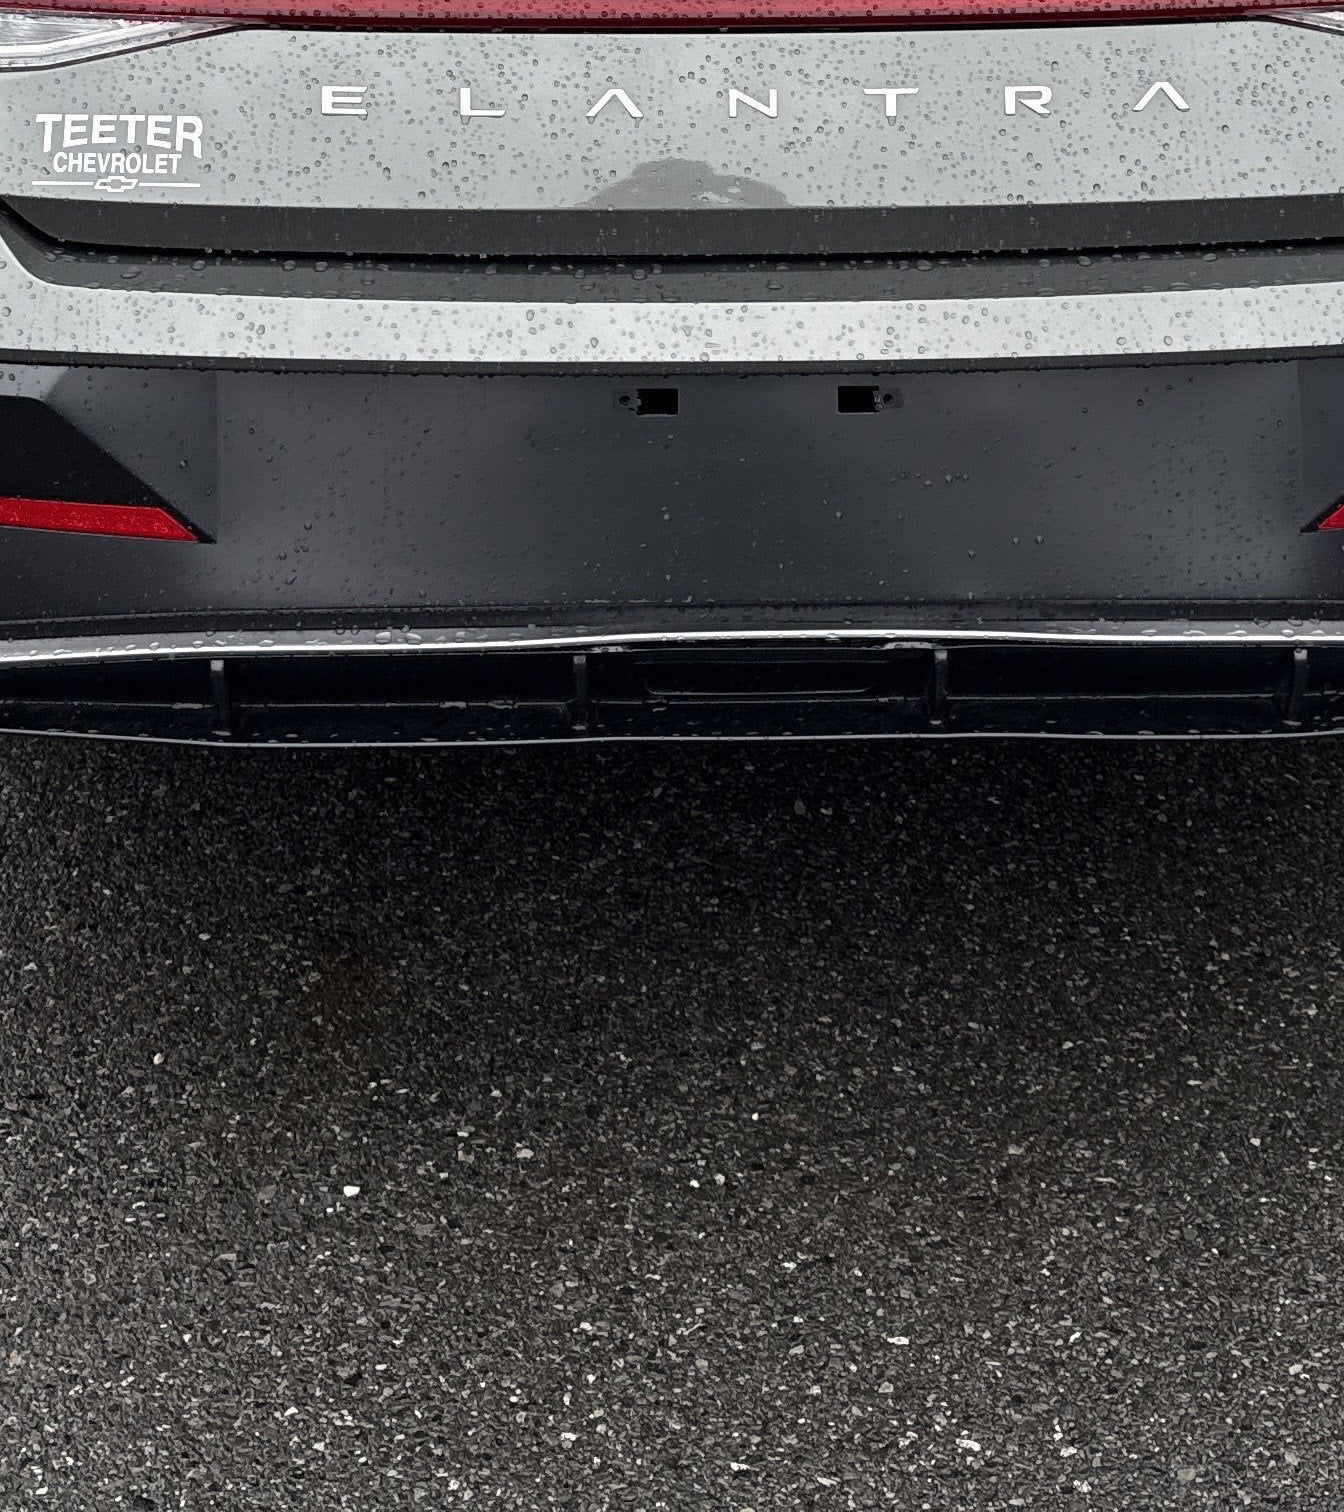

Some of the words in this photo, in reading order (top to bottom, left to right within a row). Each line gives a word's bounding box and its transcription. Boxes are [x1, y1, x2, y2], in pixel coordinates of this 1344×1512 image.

[321, 81, 1191, 118] ELANTRA
[35, 113, 204, 159] TEETER
[53, 151, 182, 174] CHEVROLET
